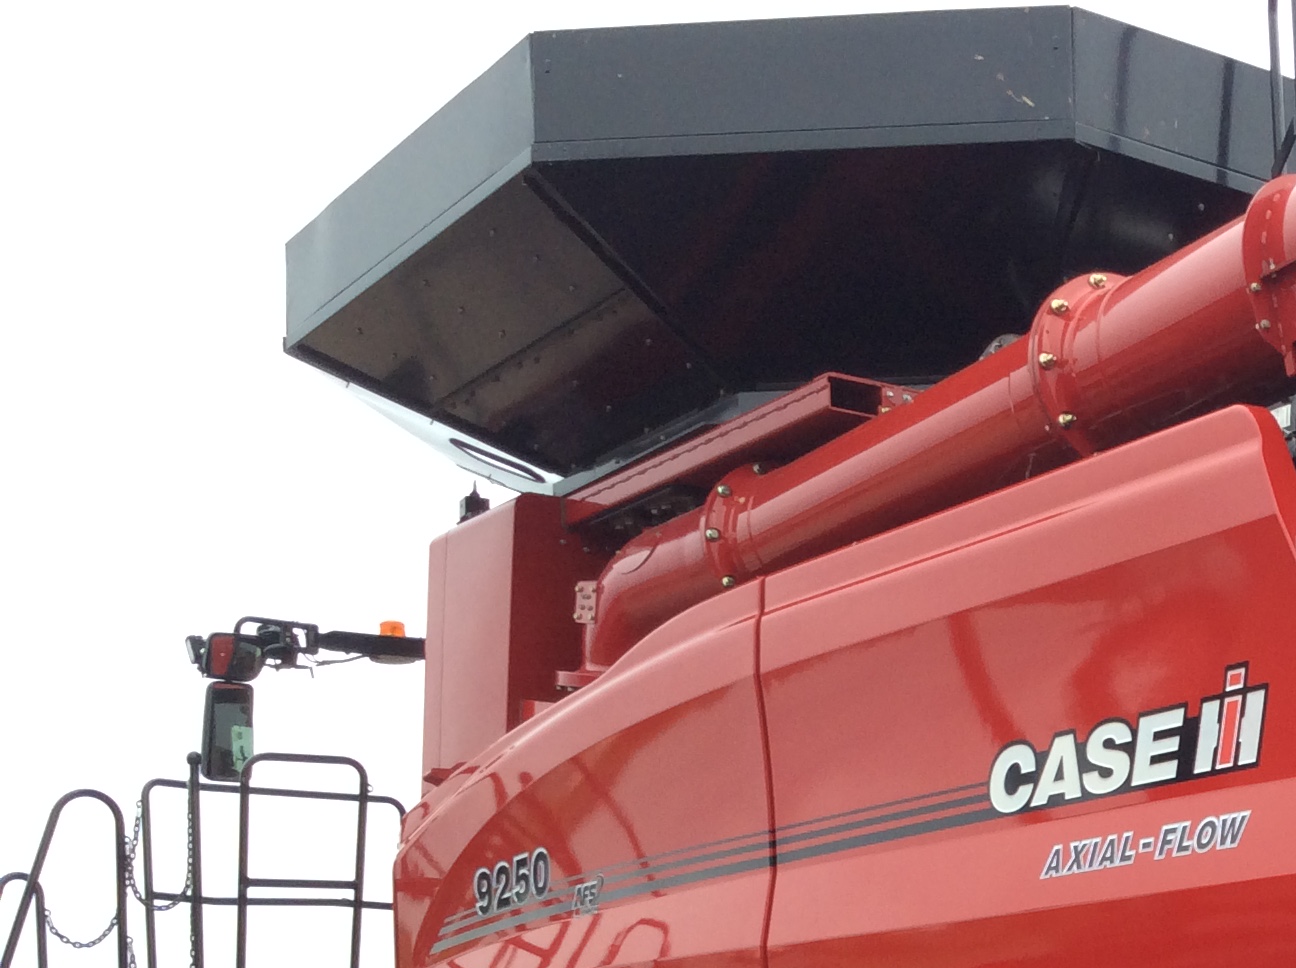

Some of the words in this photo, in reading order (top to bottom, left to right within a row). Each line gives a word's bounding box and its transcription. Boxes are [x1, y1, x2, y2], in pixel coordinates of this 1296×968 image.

[989, 704, 1186, 814] CASE
[1039, 810, 1252, 880] AXIAL-FLOW
[473, 847, 550, 917] 9250
